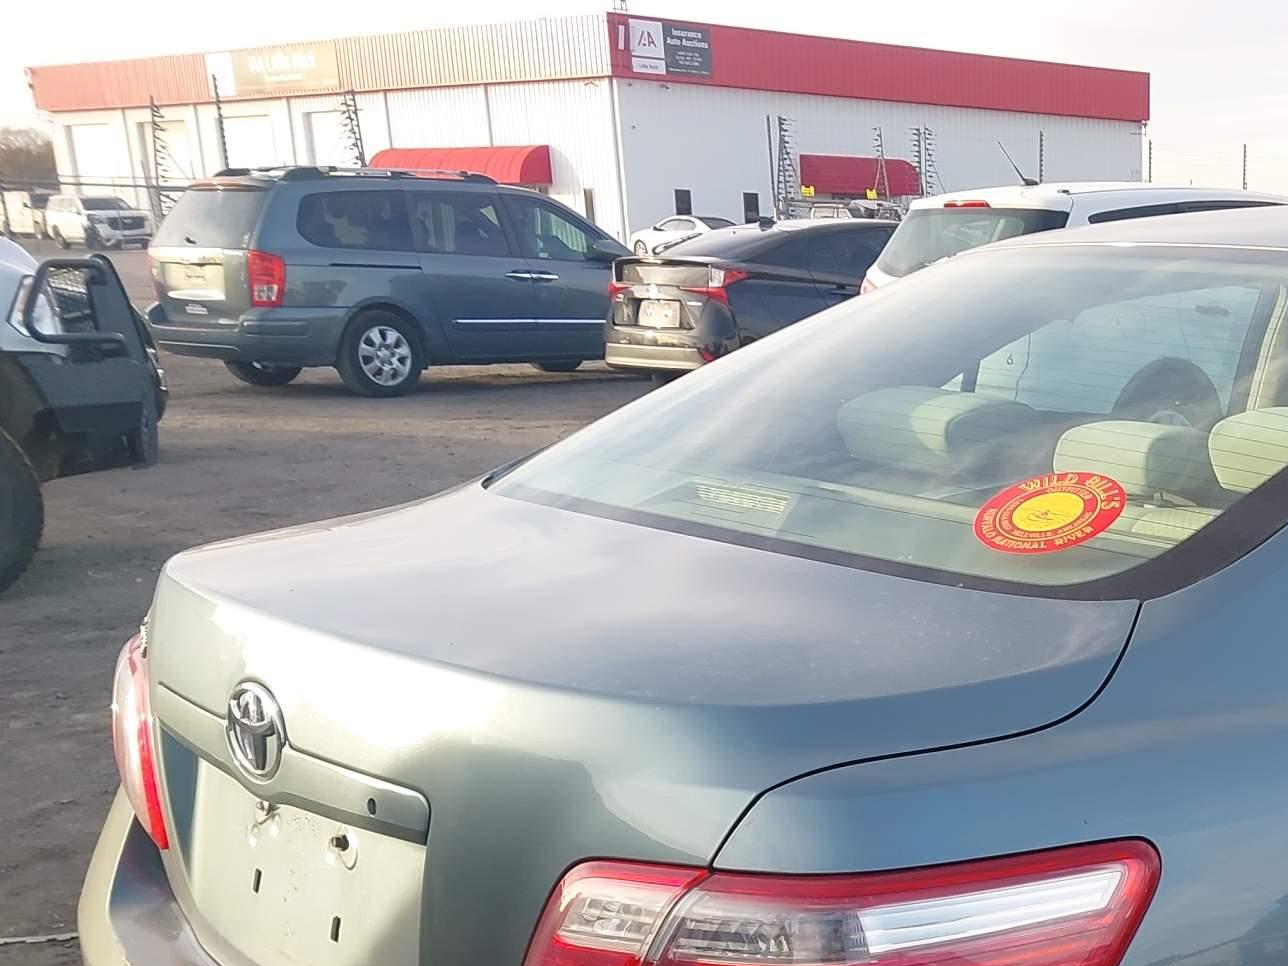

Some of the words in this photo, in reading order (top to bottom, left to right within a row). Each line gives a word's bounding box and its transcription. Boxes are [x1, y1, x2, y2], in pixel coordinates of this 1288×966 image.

[671, 27, 702, 39] Insurance
[666, 36, 681, 46] Auto
[682, 38, 709, 49] Auctions
[1018, 473, 1079, 492] WILD
[1085, 476, 1120, 510] BILL'S
[992, 535, 1047, 549] NATIONAL
[1054, 526, 1094, 546] RIVER
